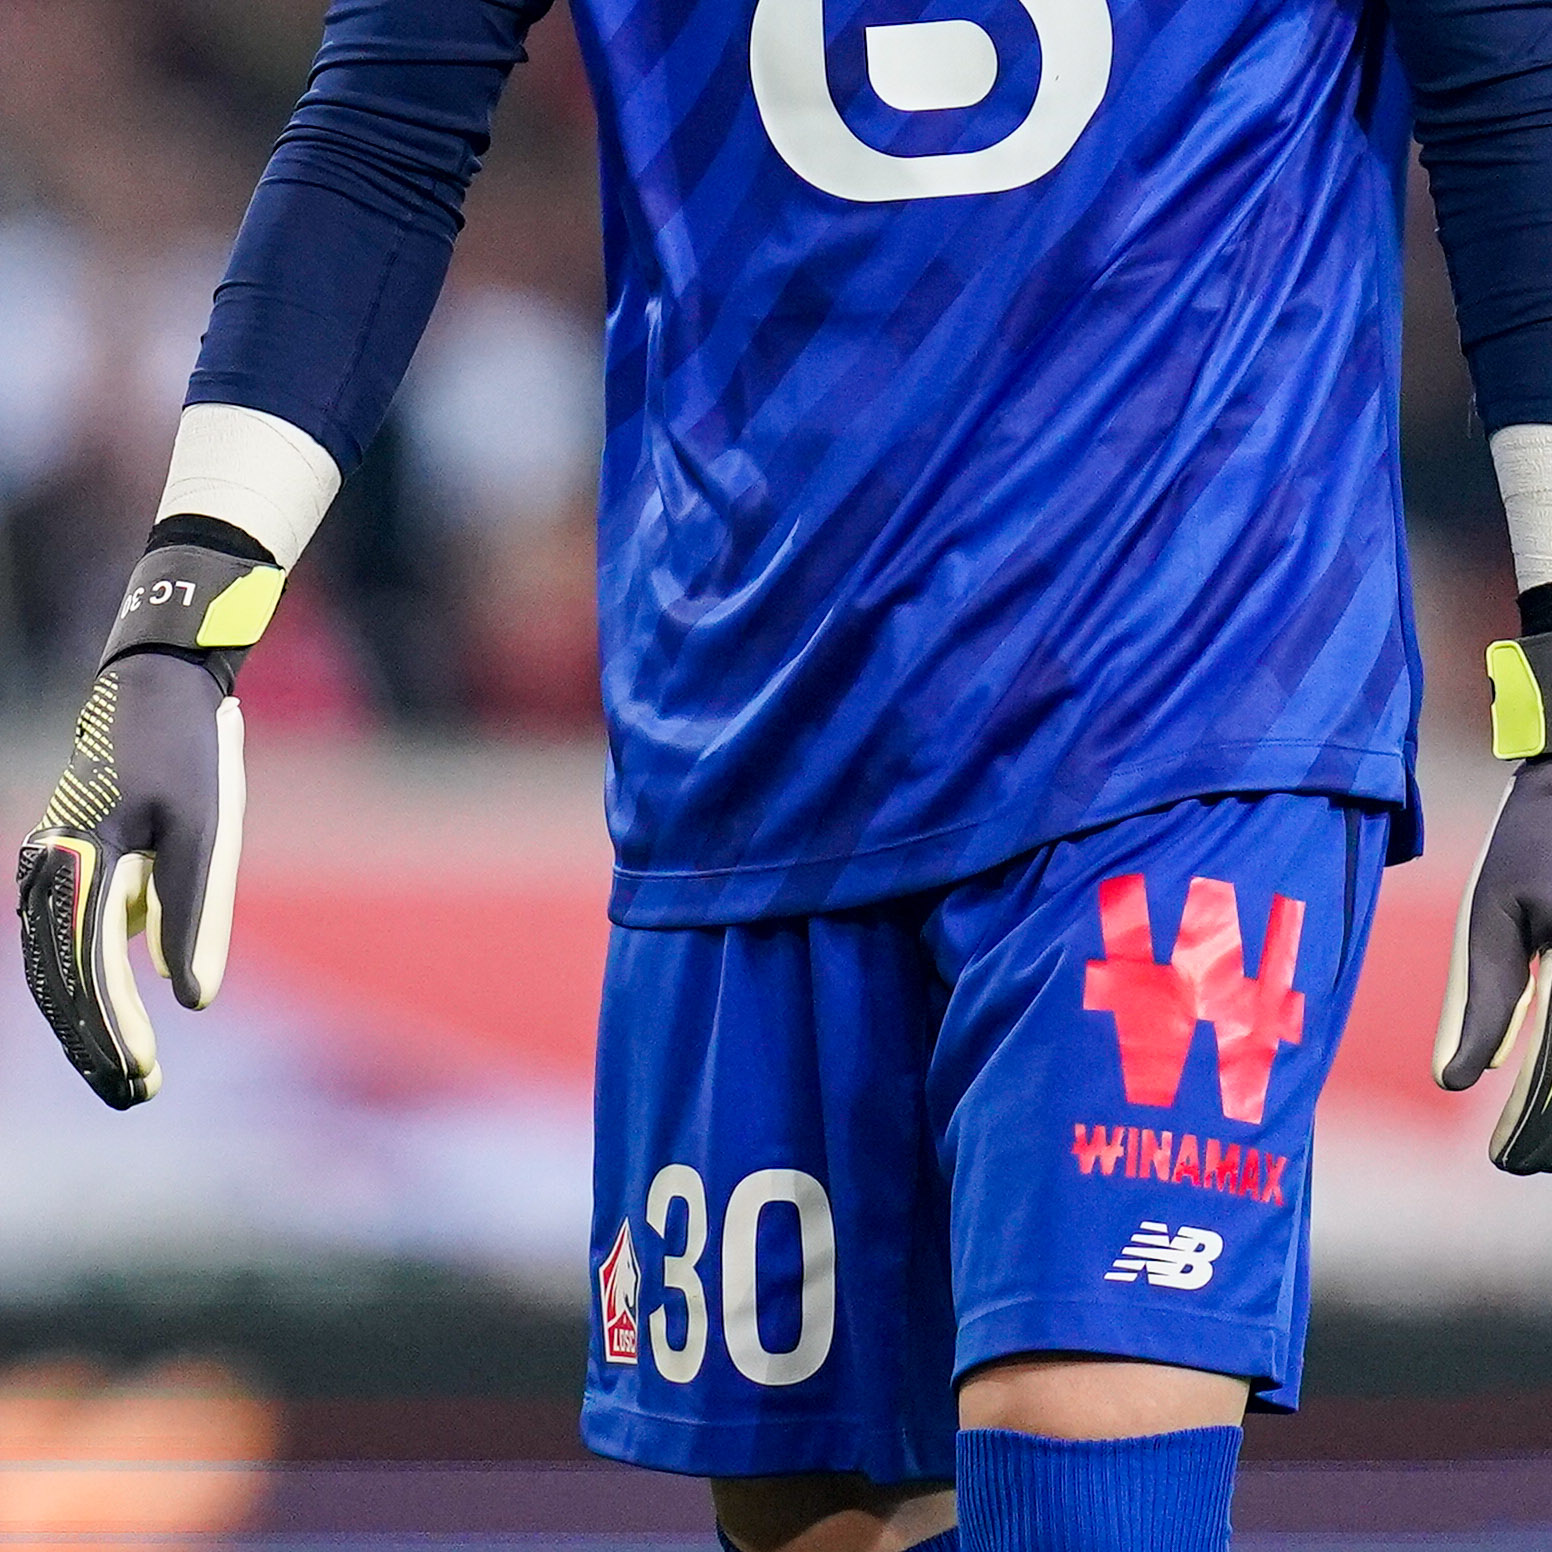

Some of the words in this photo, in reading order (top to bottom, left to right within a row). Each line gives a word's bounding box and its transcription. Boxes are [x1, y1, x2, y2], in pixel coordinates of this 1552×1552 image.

[149, 580, 196, 607] LC
[1072, 1123, 1288, 1206] WINAMAX
[646, 1163, 836, 1386] 30
